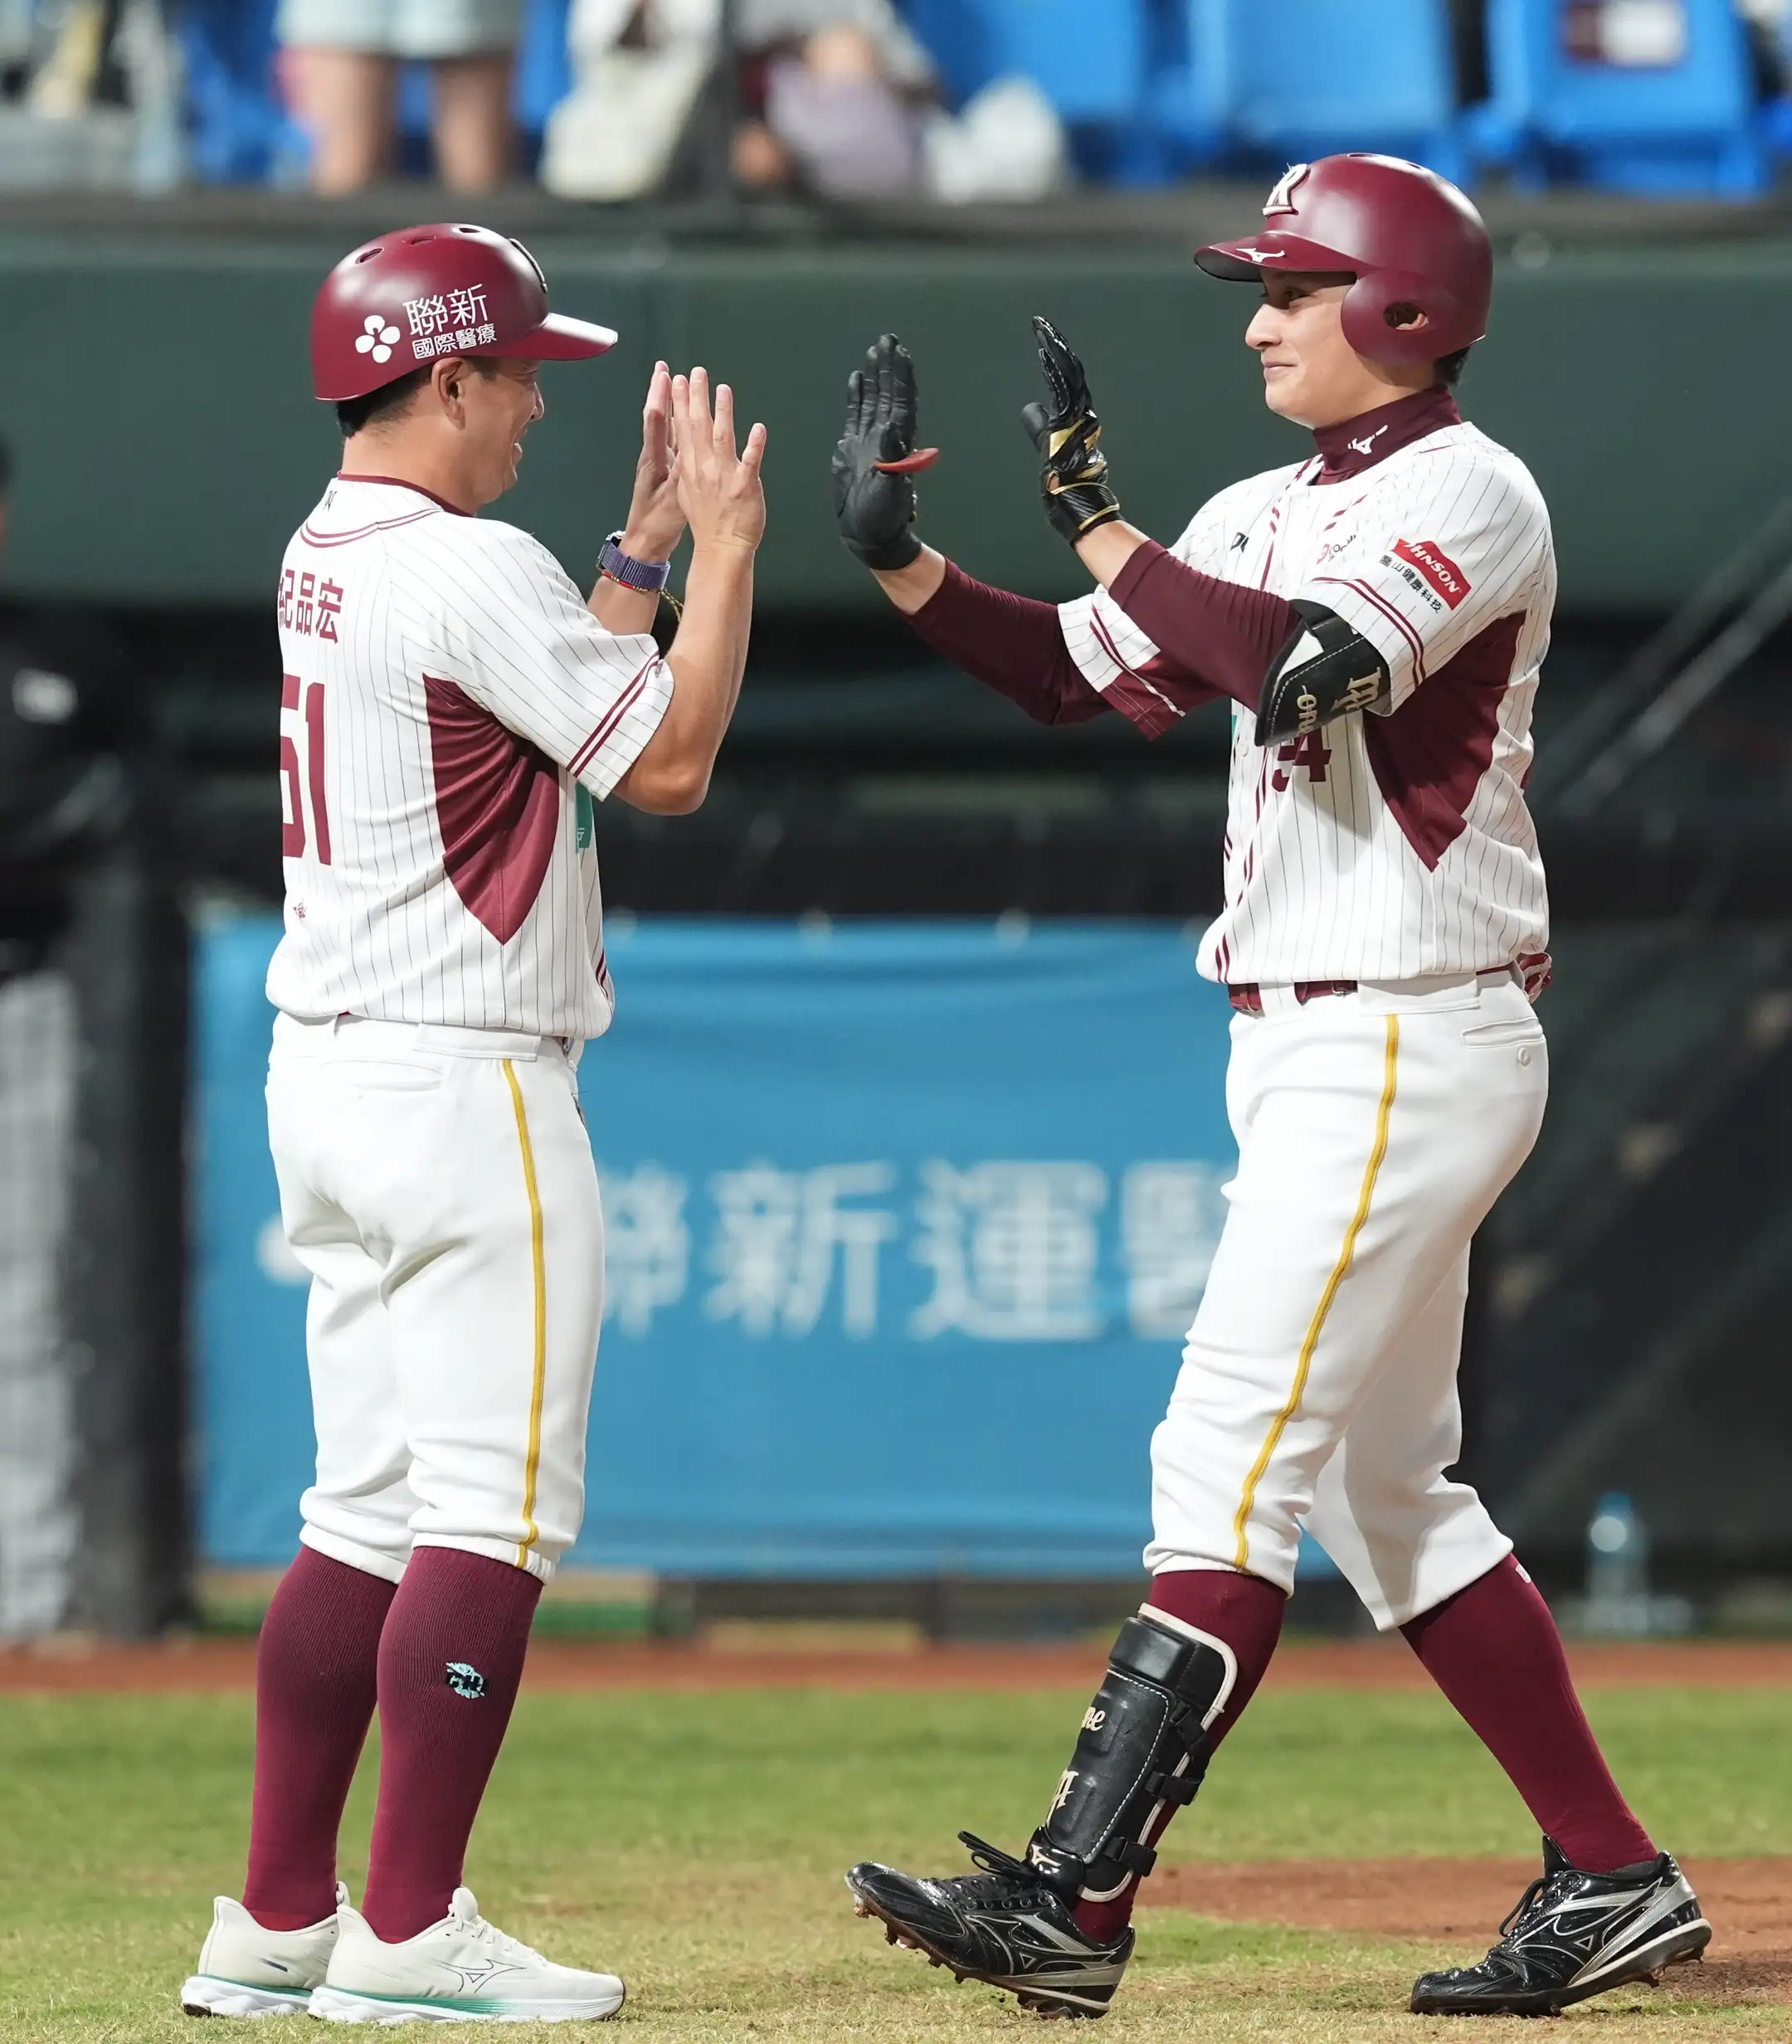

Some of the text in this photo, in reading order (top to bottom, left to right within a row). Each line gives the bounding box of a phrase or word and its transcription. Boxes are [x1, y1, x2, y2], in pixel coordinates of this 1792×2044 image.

[402, 284, 488, 336] 聯新
[412, 323, 497, 359] 國際醫療
[1379, 554, 1443, 614] 喬山健康科技
